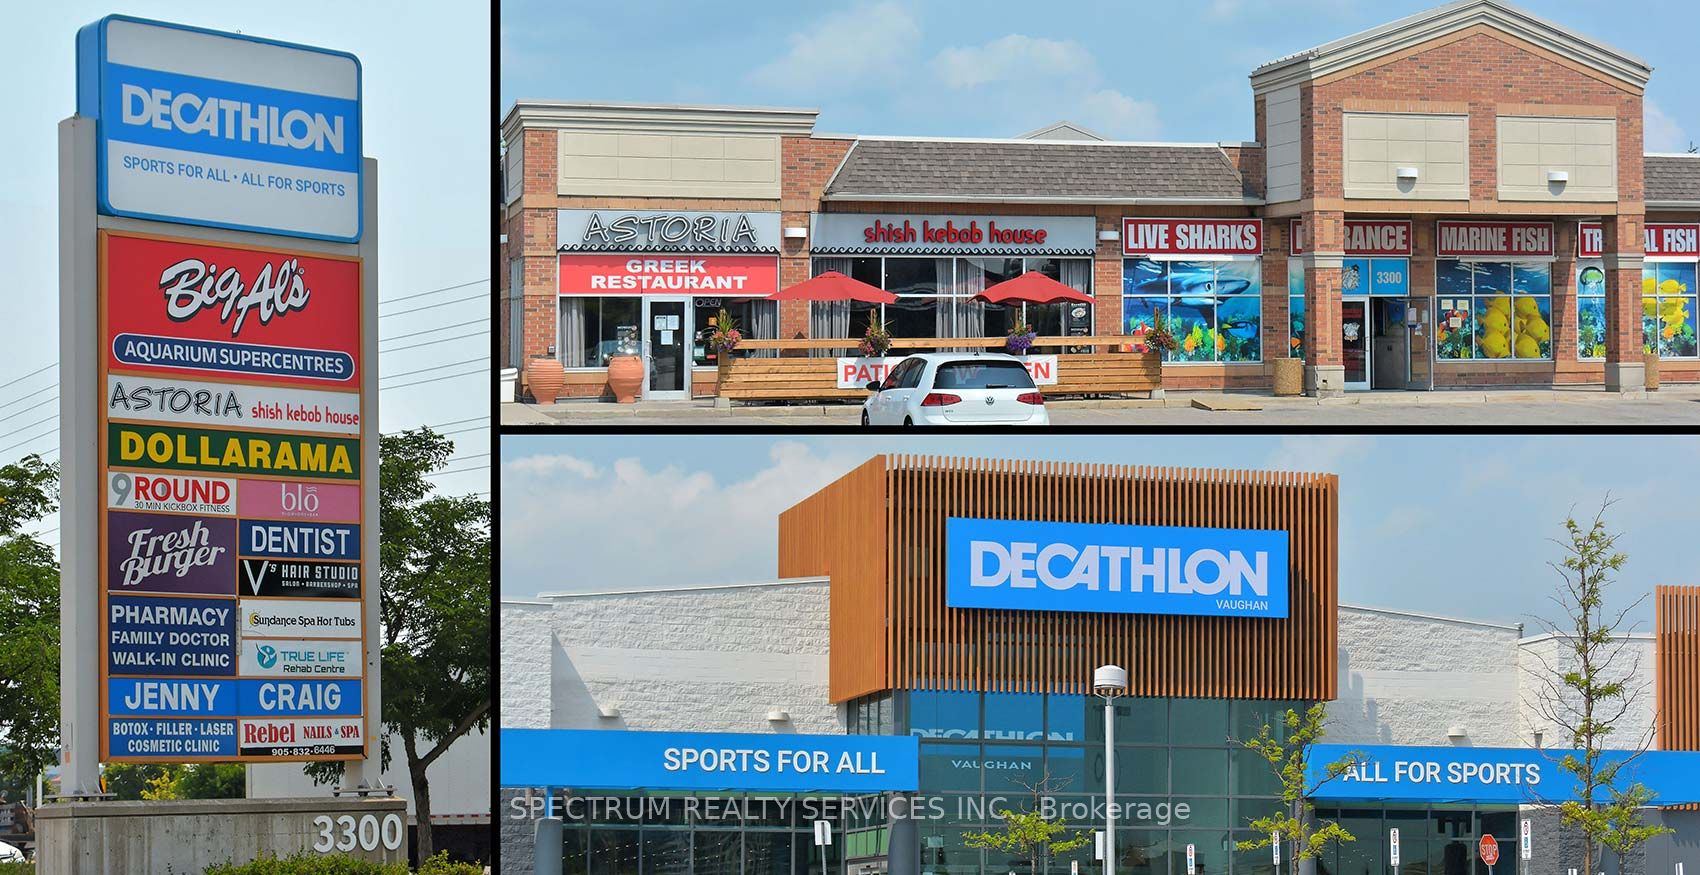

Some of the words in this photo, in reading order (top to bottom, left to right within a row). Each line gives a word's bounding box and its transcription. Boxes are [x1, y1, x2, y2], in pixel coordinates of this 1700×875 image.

[122, 83, 344, 154] DECATHLON
[123, 155, 175, 175] SPORTS
[178, 163, 203, 179] FOR
[206, 167, 230, 183] ALL
[241, 172, 265, 187] ALL
[268, 175, 293, 190] FOR
[296, 179, 345, 197] SPORTS
[583, 211, 758, 244] ASTORIA
[864, 219, 917, 243] shish
[923, 220, 983, 244] kebob
[989, 220, 1048, 245] house
[1127, 223, 1169, 250] LIVE
[1175, 223, 1258, 250] SHARKS
[1441, 226, 1507, 251] MARINE
[1512, 227, 1549, 252] FISH
[1663, 228, 1697, 252] FISH
[625, 259, 707, 274] GREEK
[1376, 271, 1402, 285] 3300
[160, 257, 245, 323] Big
[591, 275, 748, 290] RESTAURANT
[124, 340, 217, 364] AQUARIUM
[219, 349, 344, 374] SUPERCENTRES
[844, 364, 898, 382] PATI
[109, 381, 244, 419] ASTORIA
[252, 401, 283, 421] shish
[286, 402, 321, 423] kebob
[325, 406, 359, 426] house
[120, 430, 353, 474] DOLLARAMA
[135, 501, 144, 509] 30
[146, 502, 161, 510] MIN
[163, 502, 198, 512] KICKBOX
[200, 504, 230, 513] FITNESS
[127, 520, 210, 558] Fresh
[251, 525, 351, 555] DENTIST
[119, 546, 226, 587] Burger
[281, 564, 310, 579] HAIR
[315, 565, 359, 581] STUDIO
[970, 540, 1269, 597] DECATHLON
[111, 605, 230, 627] PHARMACY
[1215, 599, 1269, 611] VAUGHAN
[253, 615, 297, 628] Sundance
[298, 615, 316, 628] Spa
[317, 616, 333, 626] Hot
[334, 616, 356, 627] Tubs
[111, 631, 164, 646] FAMILY
[169, 631, 230, 648] DOCTOR
[112, 651, 177, 667] WALK-IN
[181, 652, 230, 668] CLINIC
[280, 651, 315, 662] TRUE
[318, 651, 345, 662] LIFE
[283, 664, 312, 673] Rehab
[314, 664, 345, 673] Centre
[125, 682, 220, 711] JENNY
[258, 682, 342, 711] CRAIG
[112, 721, 149, 736] BOTOX
[156, 722, 193, 736] FILLER
[200, 722, 234, 736] LASER
[244, 723, 296, 744] Rebel
[303, 725, 332, 739] NAILS
[340, 725, 360, 738] SPA
[127, 739, 182, 753] COSMETIC
[184, 739, 220, 753] CLINIC
[663, 748, 771, 773] SPORTS
[777, 750, 830, 774] FOR
[835, 751, 886, 775] ALL
[951, 760, 1032, 770] VAUGHAN
[1343, 761, 1388, 783] ALL
[1394, 761, 1442, 784] FOR
[1447, 761, 1541, 786] SPORTS
[313, 813, 403, 853] 3300
[1481, 844, 1497, 855] STOP
